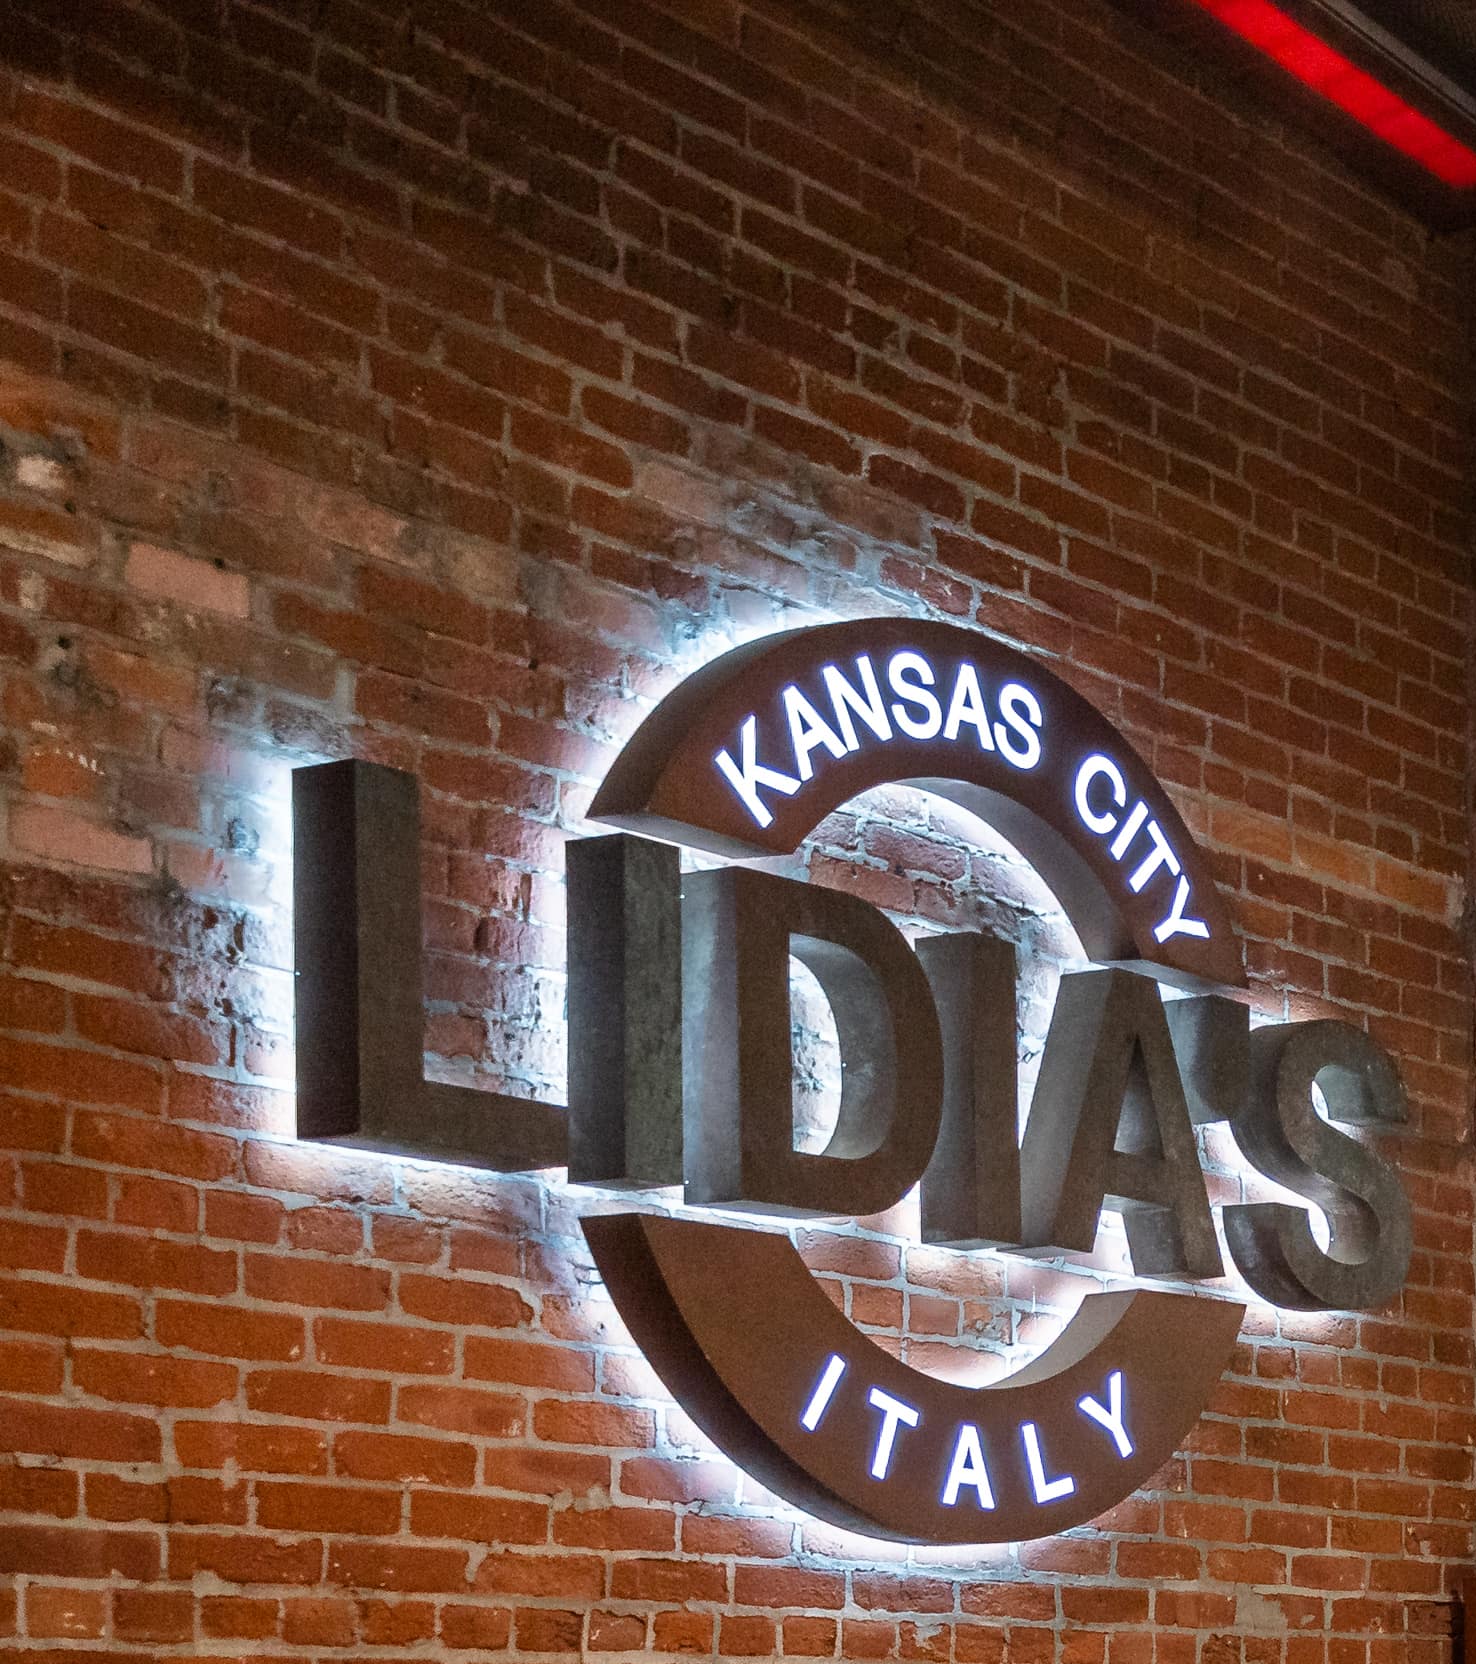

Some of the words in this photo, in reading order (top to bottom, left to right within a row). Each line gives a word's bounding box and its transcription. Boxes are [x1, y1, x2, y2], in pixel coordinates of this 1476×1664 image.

[713, 650, 1044, 830] KANSAS
[1073, 752, 1212, 945] CITY
[291, 757, 1413, 1312] LIDIA'S
[800, 1353, 1135, 1511] ITALY
